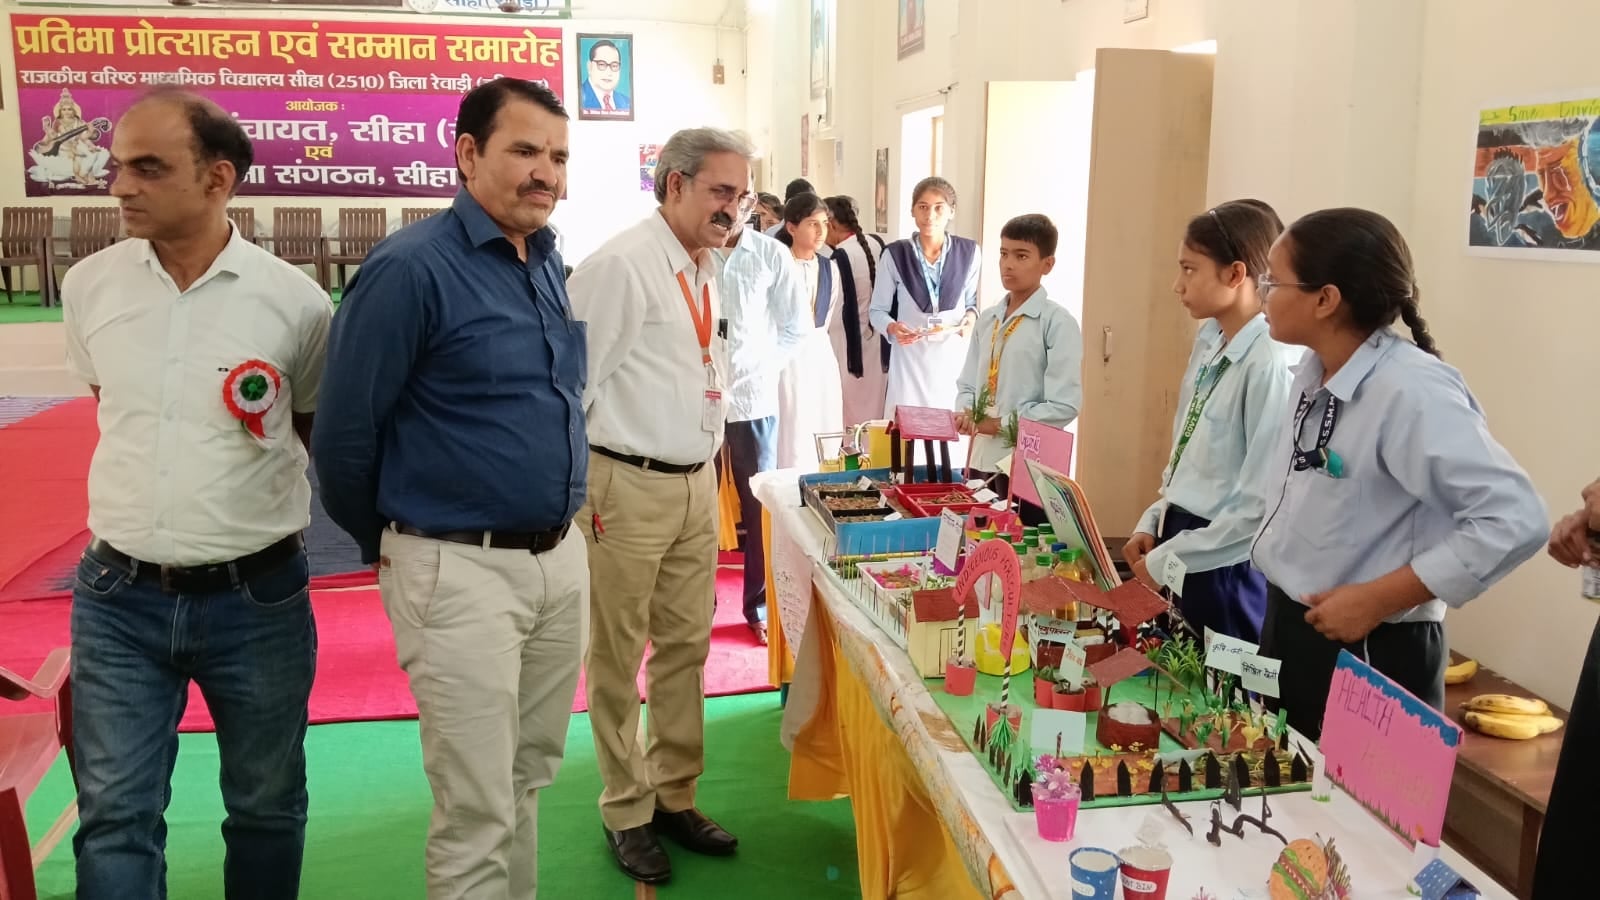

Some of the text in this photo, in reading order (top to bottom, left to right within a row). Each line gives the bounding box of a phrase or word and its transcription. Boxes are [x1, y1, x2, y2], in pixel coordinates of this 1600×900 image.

[15, 17, 562, 67] प्रतिभा प्रोत्साहन एवं सम्मान समारोह
[20, 65, 87, 85] राजकीय
[91, 66, 137, 86] वरिष्ठ
[140, 67, 216, 86] माध्यमिक
[220, 68, 285, 88] विद्यालय
[289, 70, 324, 88] सीहा
[328, 73, 385, 90] (2510)
[389, 72, 427, 91] जिला
[431, 72, 472, 93] रेवाड़ी
[286, 98, 339, 112] आयोजक
[348, 115, 426, 145] सीहा
[304, 142, 334, 160] एवं
[273, 158, 385, 186] संगठन,
[1337, 671, 1394, 736] HEALTH
